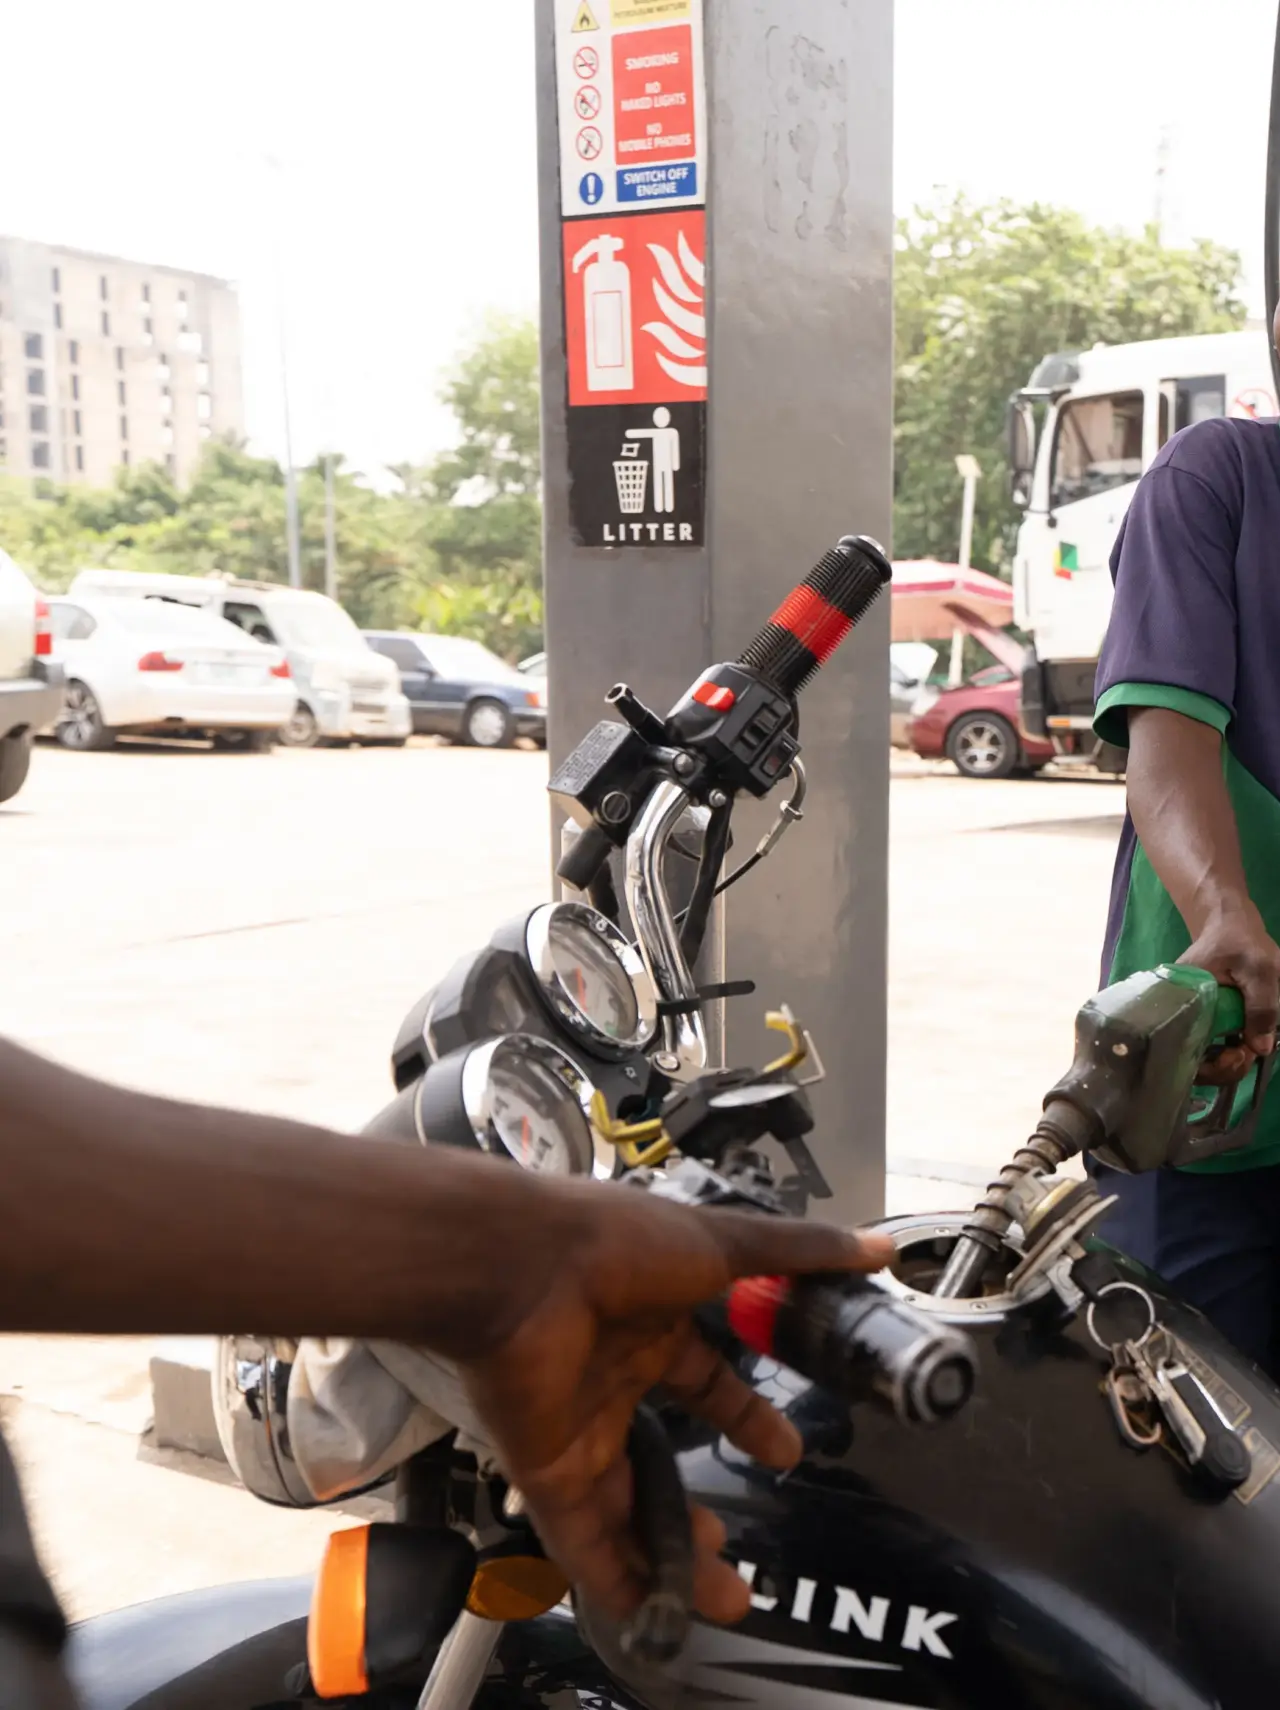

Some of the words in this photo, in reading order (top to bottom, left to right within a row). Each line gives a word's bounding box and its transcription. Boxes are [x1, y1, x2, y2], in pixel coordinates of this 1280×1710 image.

[623, 169, 667, 185] SWITCH
[667, 167, 689, 180] OFF
[636, 181, 677, 197] ENGINE
[603, 522, 693, 541] LITTER
[737, 1559, 959, 1660] LINK
